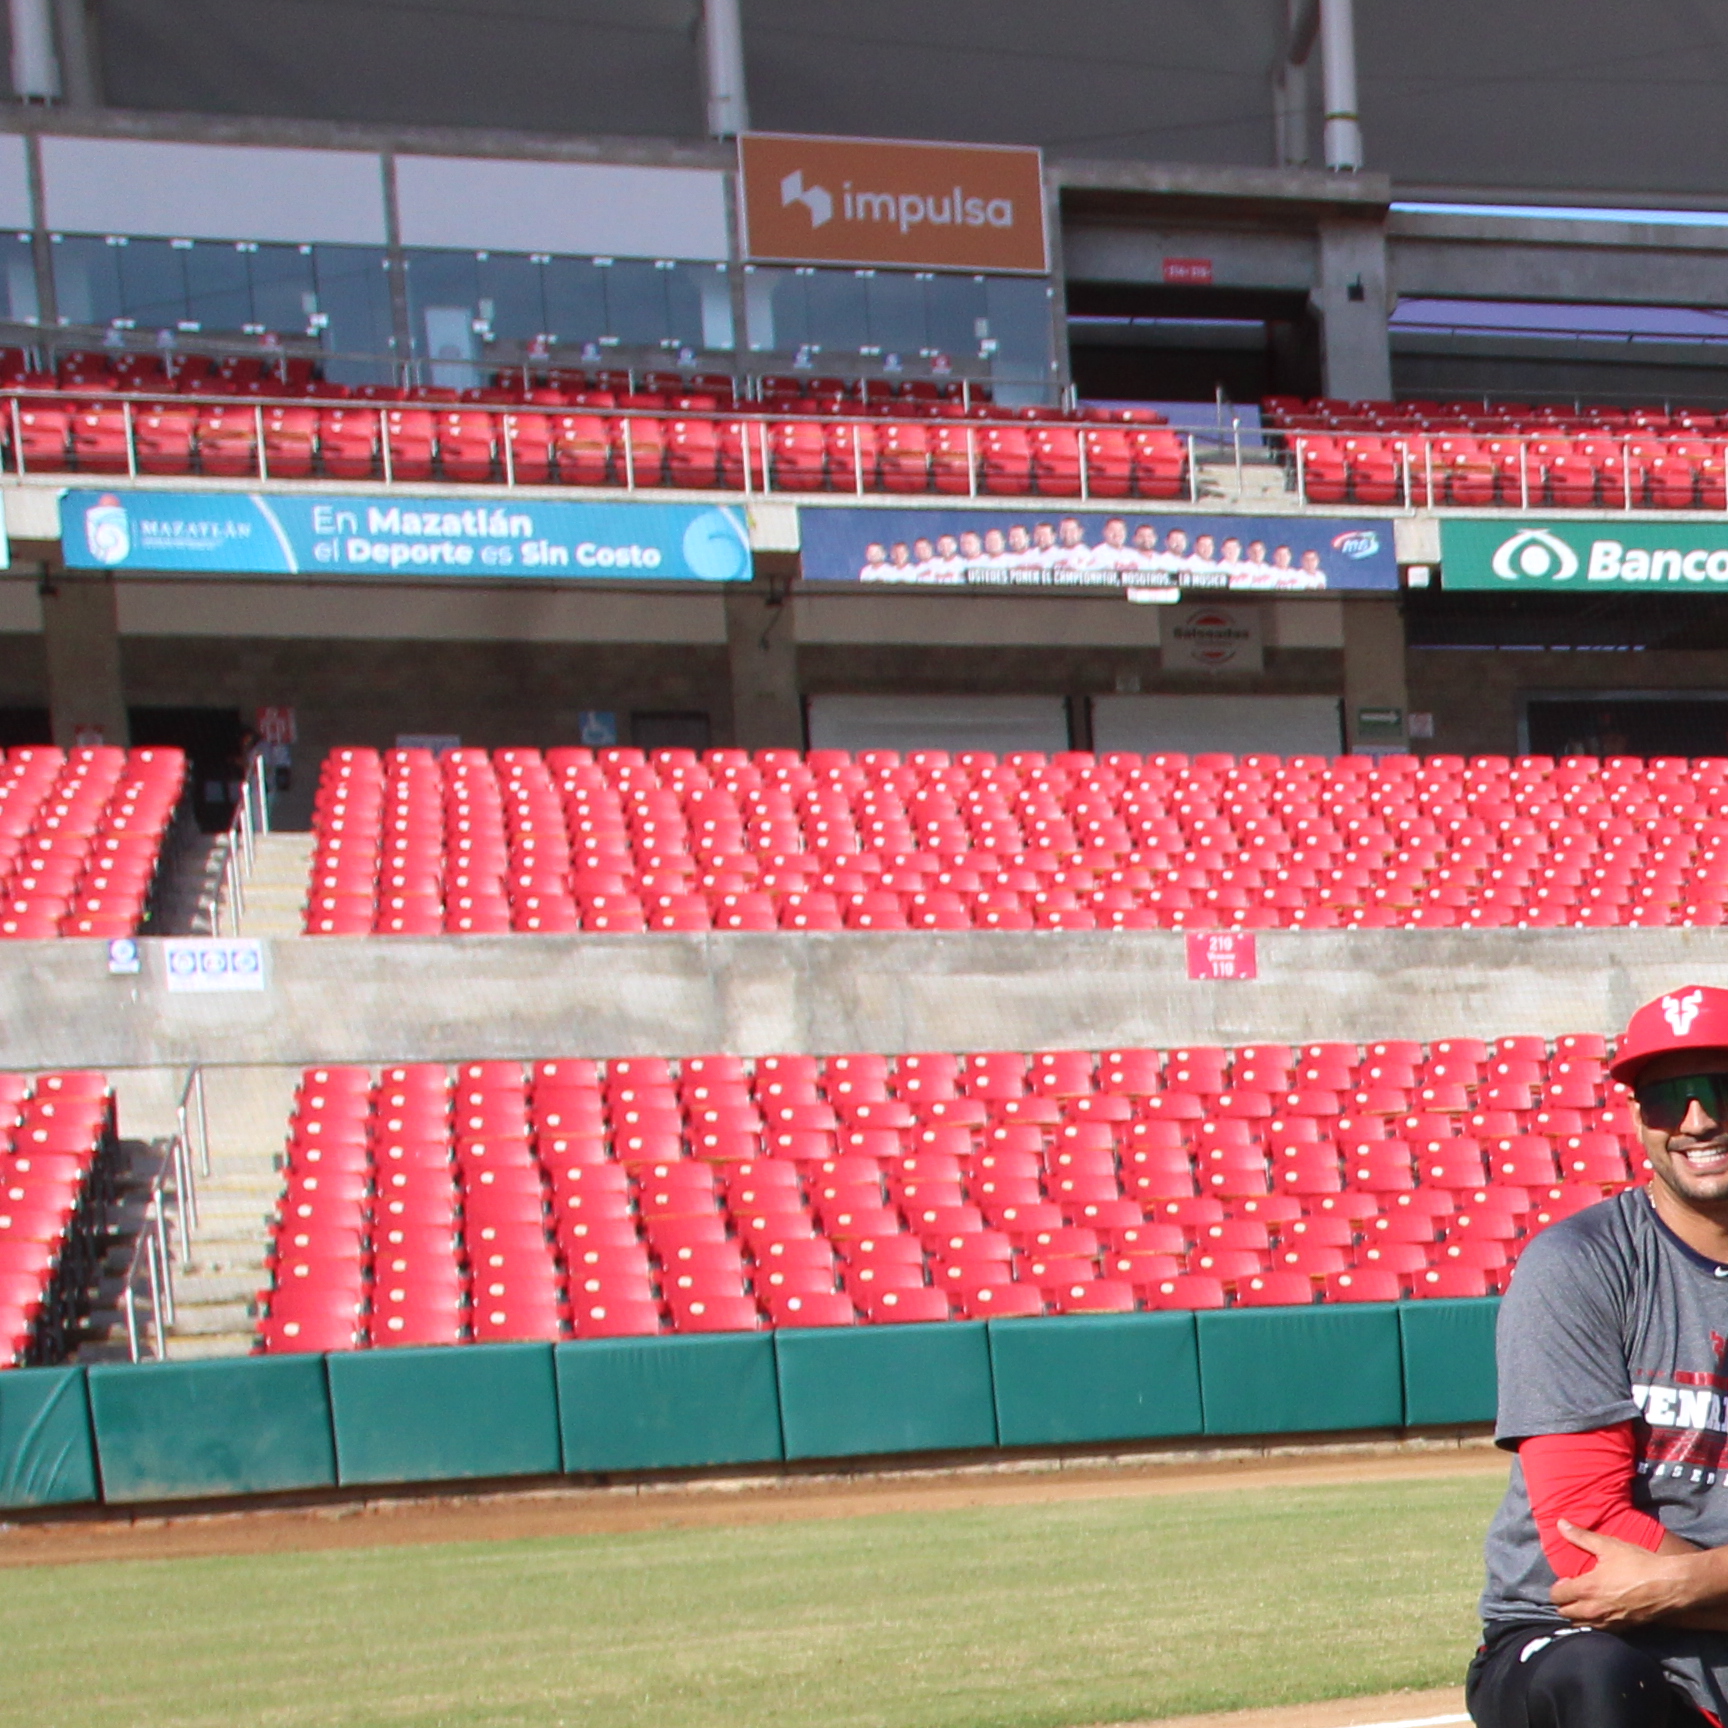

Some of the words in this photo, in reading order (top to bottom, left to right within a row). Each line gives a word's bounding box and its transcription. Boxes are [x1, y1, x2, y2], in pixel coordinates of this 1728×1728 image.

[843, 181, 1014, 234] impulsa
[313, 506, 358, 535] En
[367, 507, 534, 539] Mazatlán
[314, 538, 340, 563] el
[347, 538, 474, 570] Deporte
[480, 545, 514, 567] es
[520, 540, 569, 567] Sin
[576, 542, 662, 568] Costo
